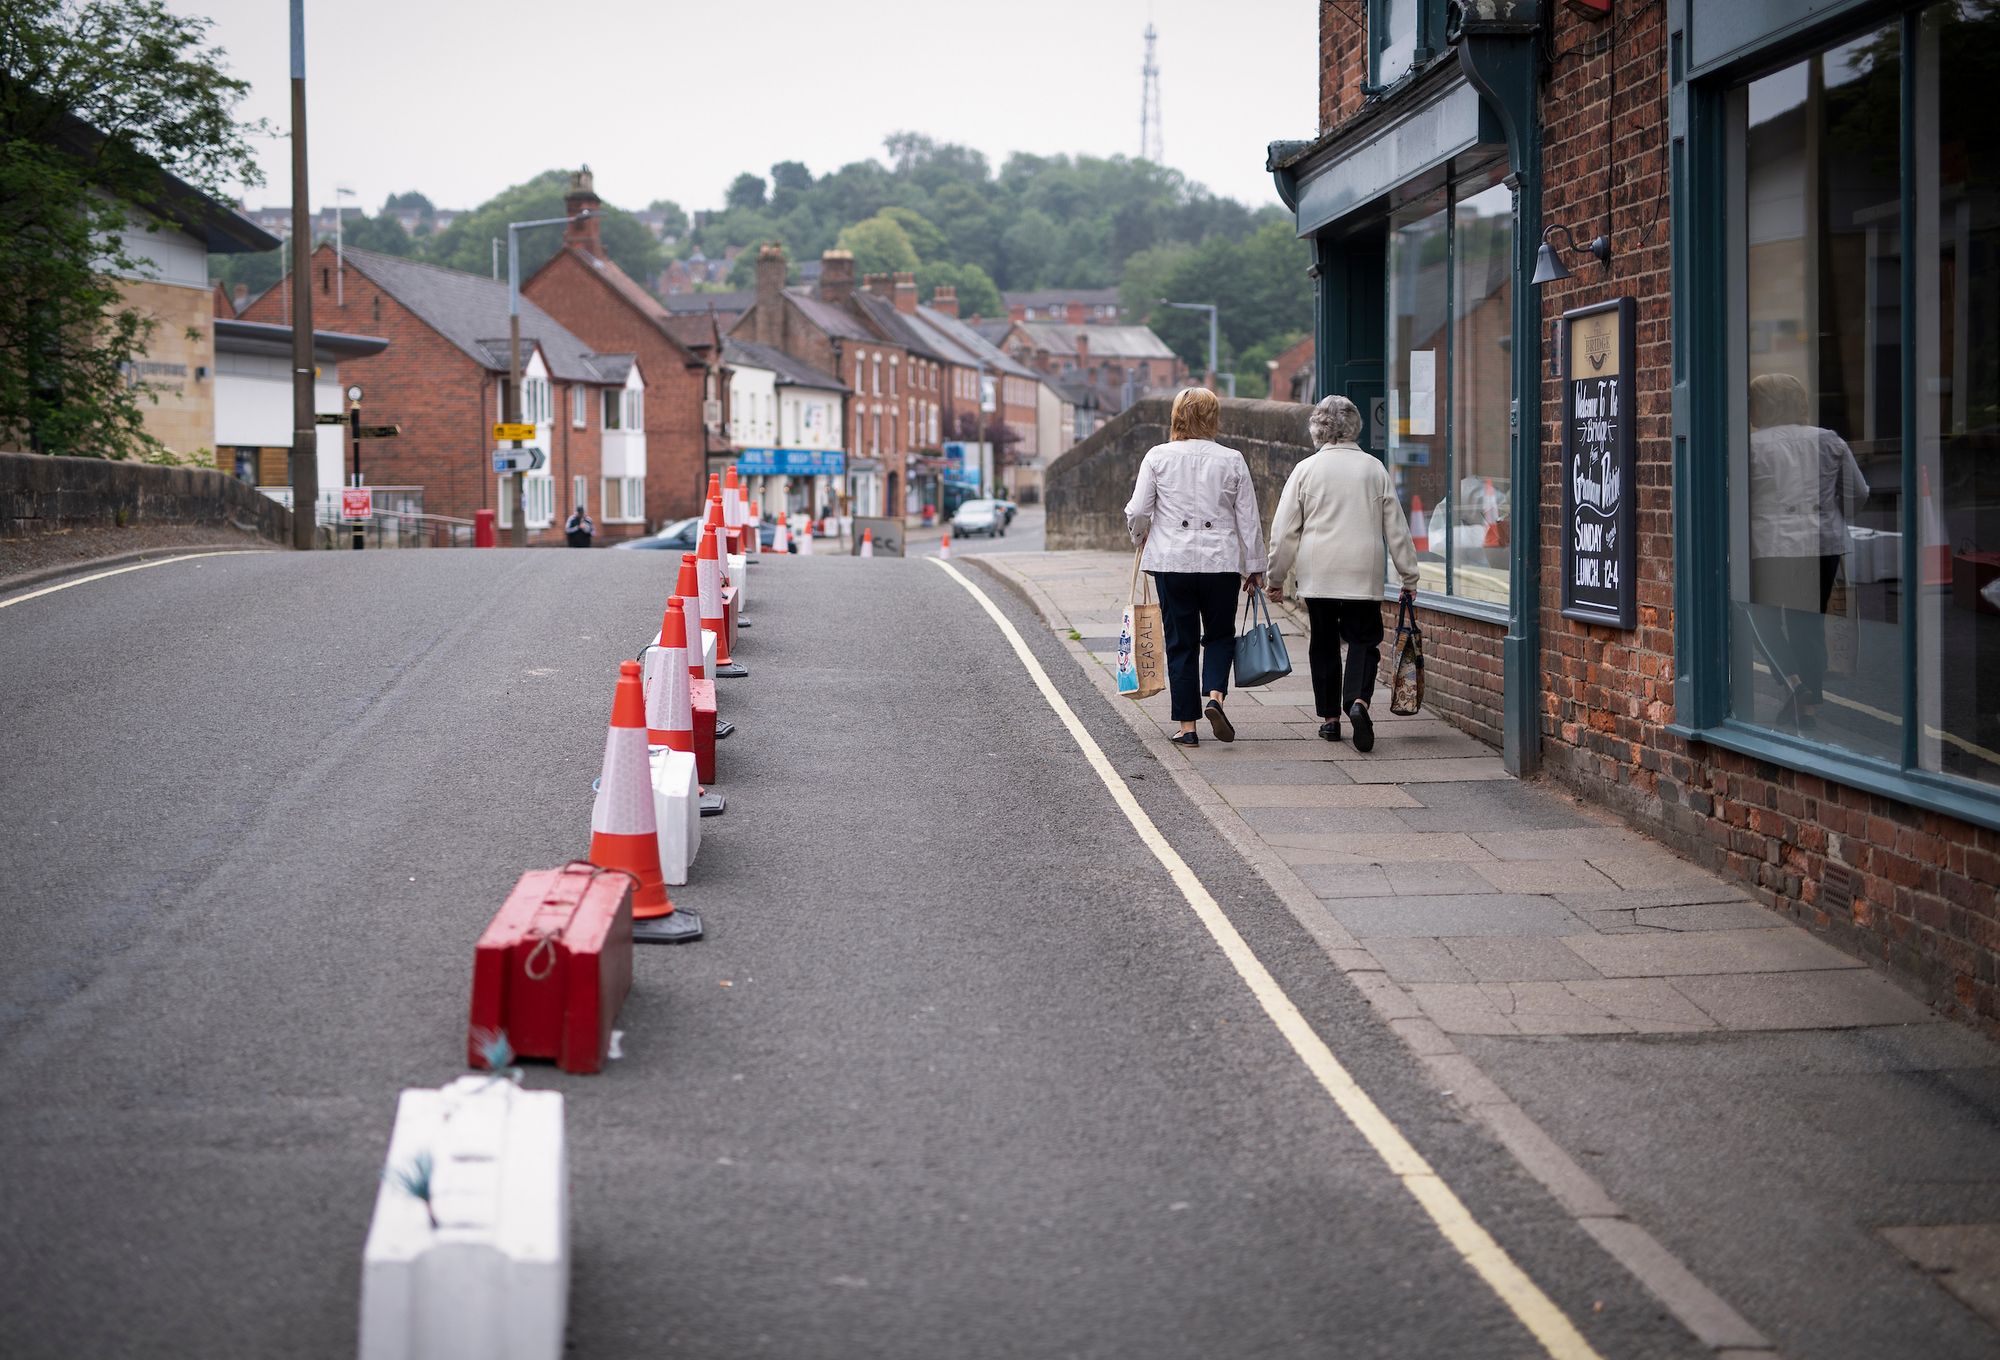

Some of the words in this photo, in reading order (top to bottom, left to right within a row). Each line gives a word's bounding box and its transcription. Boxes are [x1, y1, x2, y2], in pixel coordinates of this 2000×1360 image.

[1585, 336, 1611, 353] BRIDGE
[1598, 380, 1607, 417] To
[1587, 418, 1608, 452] Bridge
[1140, 612, 1156, 678] SEASALT
